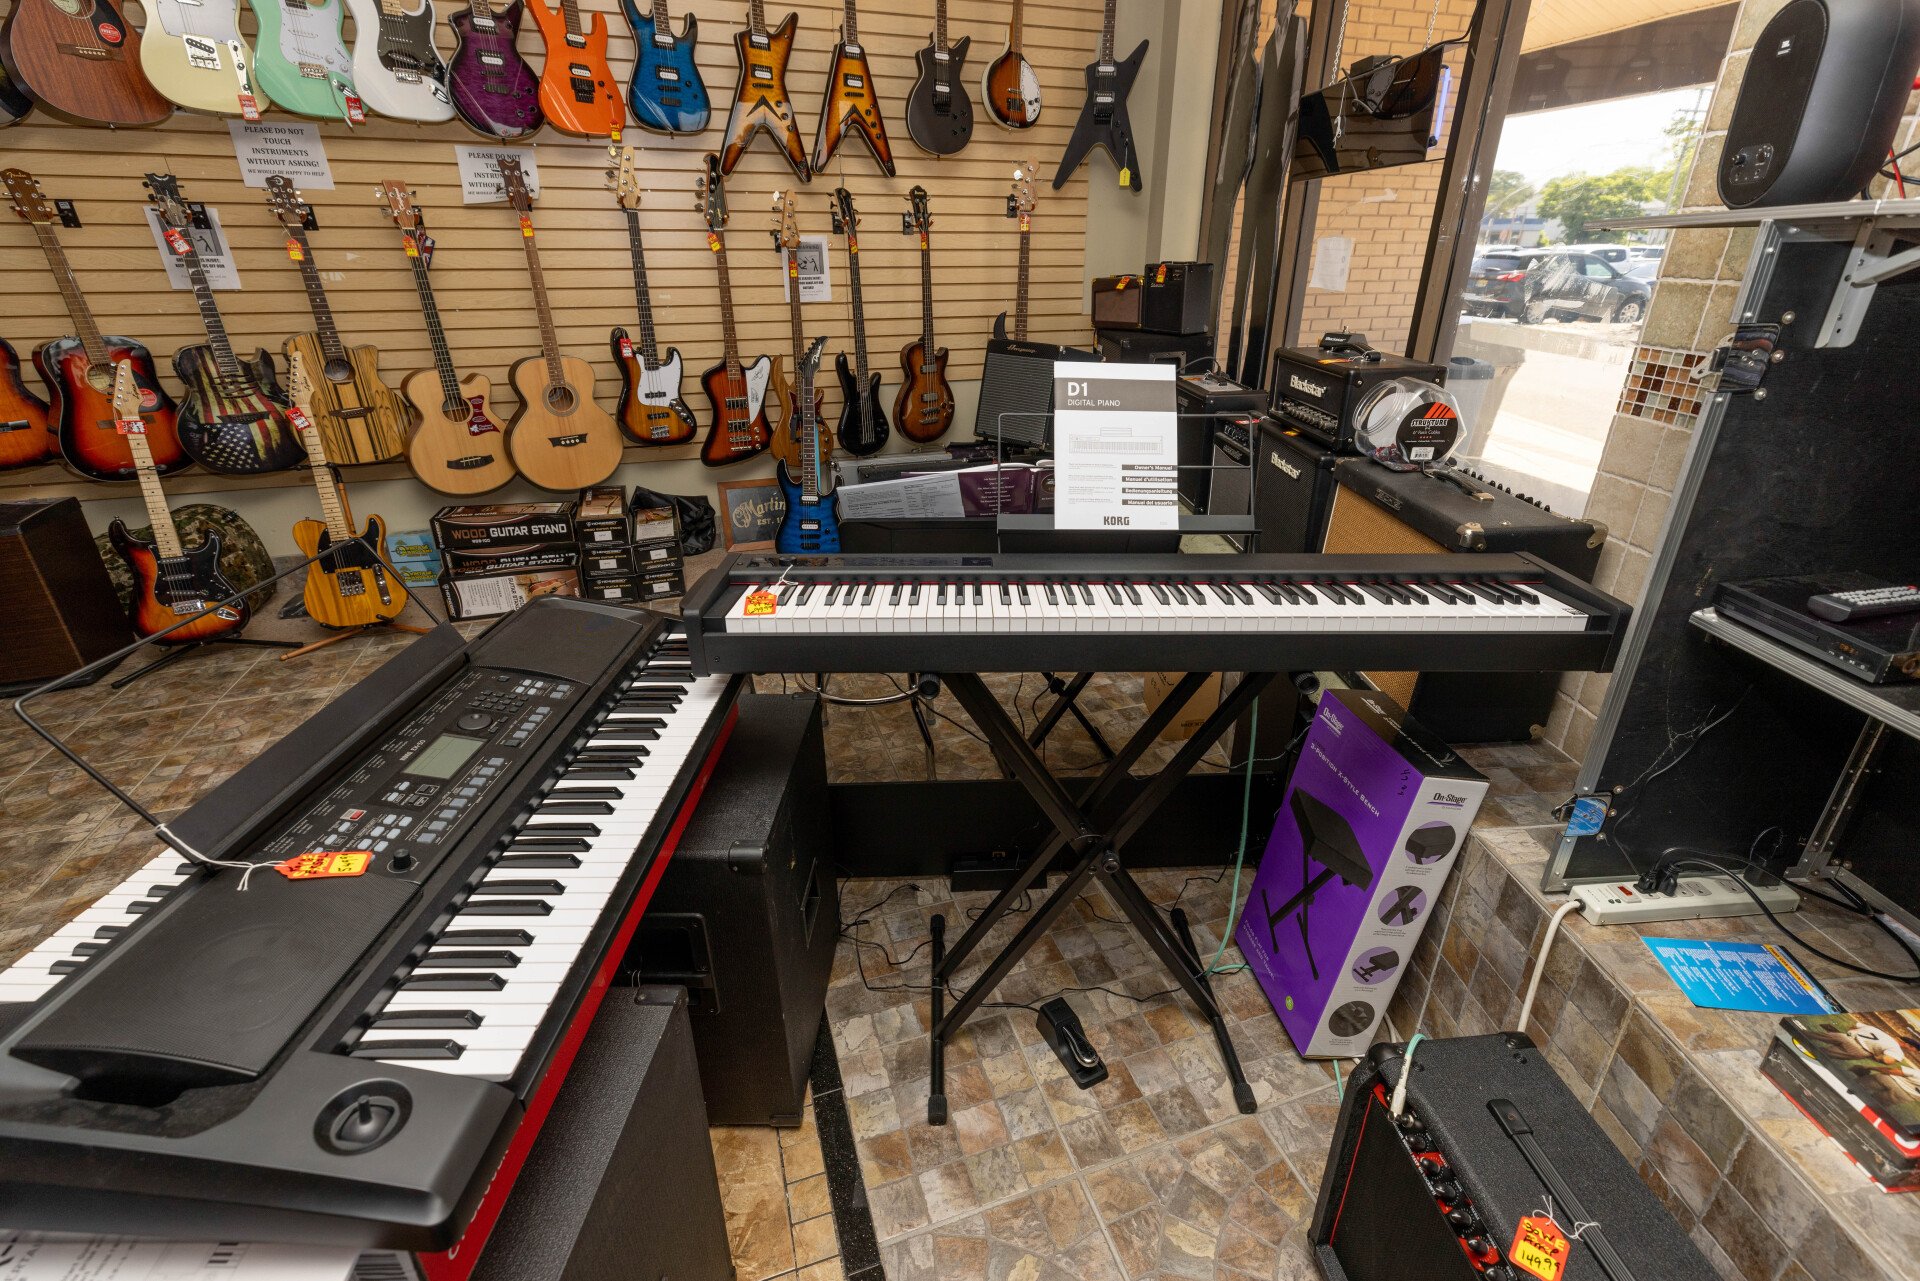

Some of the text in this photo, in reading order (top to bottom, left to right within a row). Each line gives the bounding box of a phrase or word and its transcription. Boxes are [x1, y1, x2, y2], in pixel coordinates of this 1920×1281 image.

[244, 126, 273, 134] PLEASE
[263, 137, 291, 145] TOUCH
[252, 147, 309, 157] INSTRUMENTS
[246, 157, 320, 168] WITHOUT ASKING!
[1067, 382, 1088, 397] D1
[1290, 374, 1327, 398] Blackstar
[1097, 399, 1120, 407] PIANO
[1270, 451, 1301, 480] Blackstar
[1103, 515, 1130, 526] KORG
[452, 523, 567, 540] WOOD GUITAR STAND
[1310, 742, 1380, 817] 3-POSITION X-STYLE BENCH
[1433, 792, 1466, 804] On-Stage
